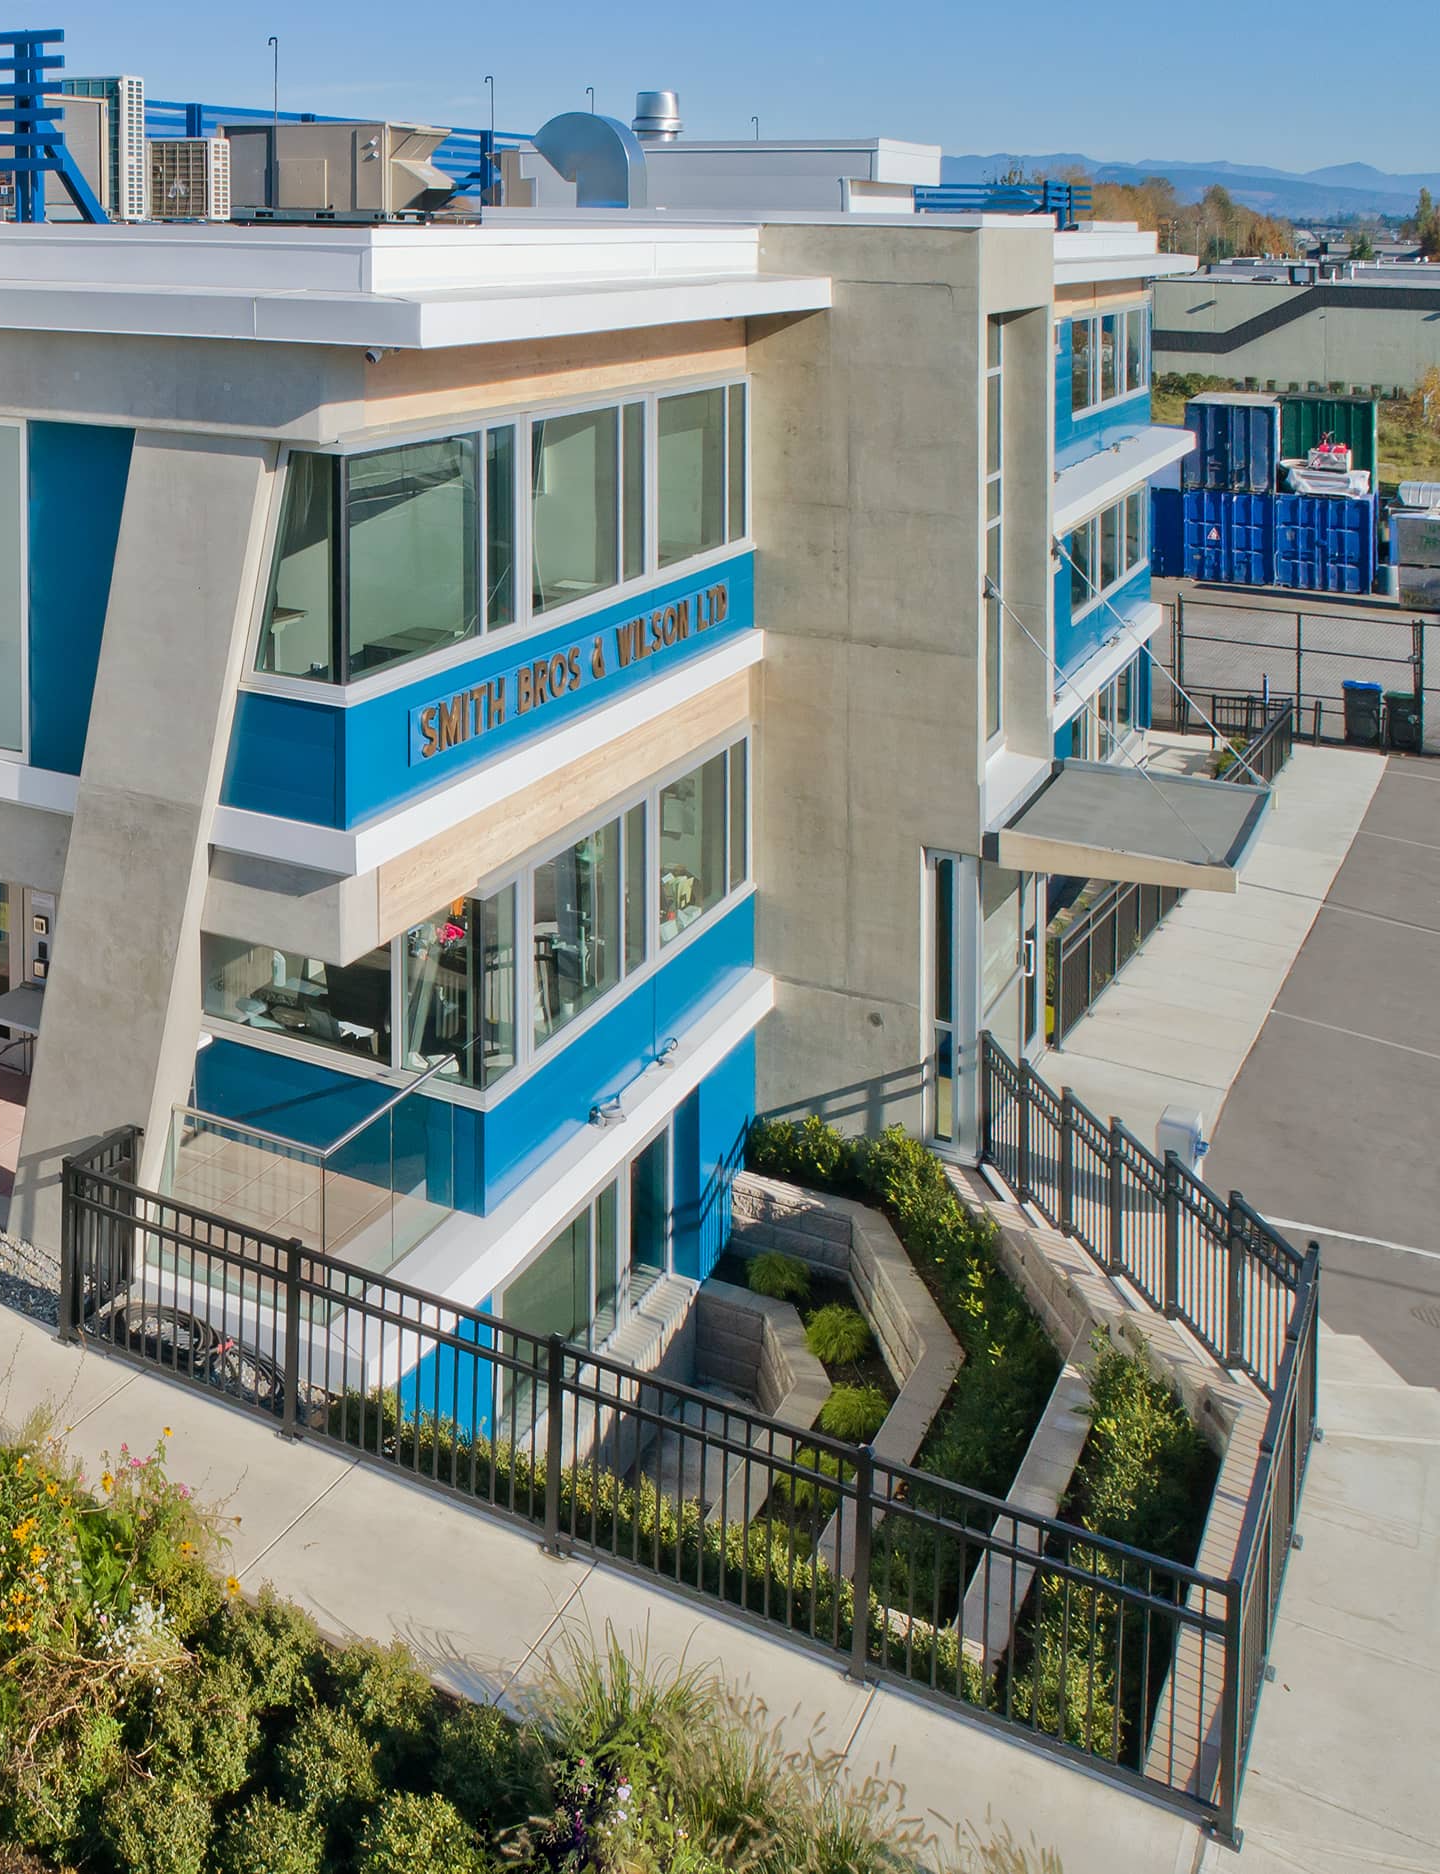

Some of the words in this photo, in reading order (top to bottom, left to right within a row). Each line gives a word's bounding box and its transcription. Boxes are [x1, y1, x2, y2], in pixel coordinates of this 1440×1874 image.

[420, 676, 506, 758] SMITH
[517, 646, 581, 715] BROS
[591, 636, 606, 679] &
[616, 600, 690, 668] WILSON
[696, 584, 728, 633] LTD
